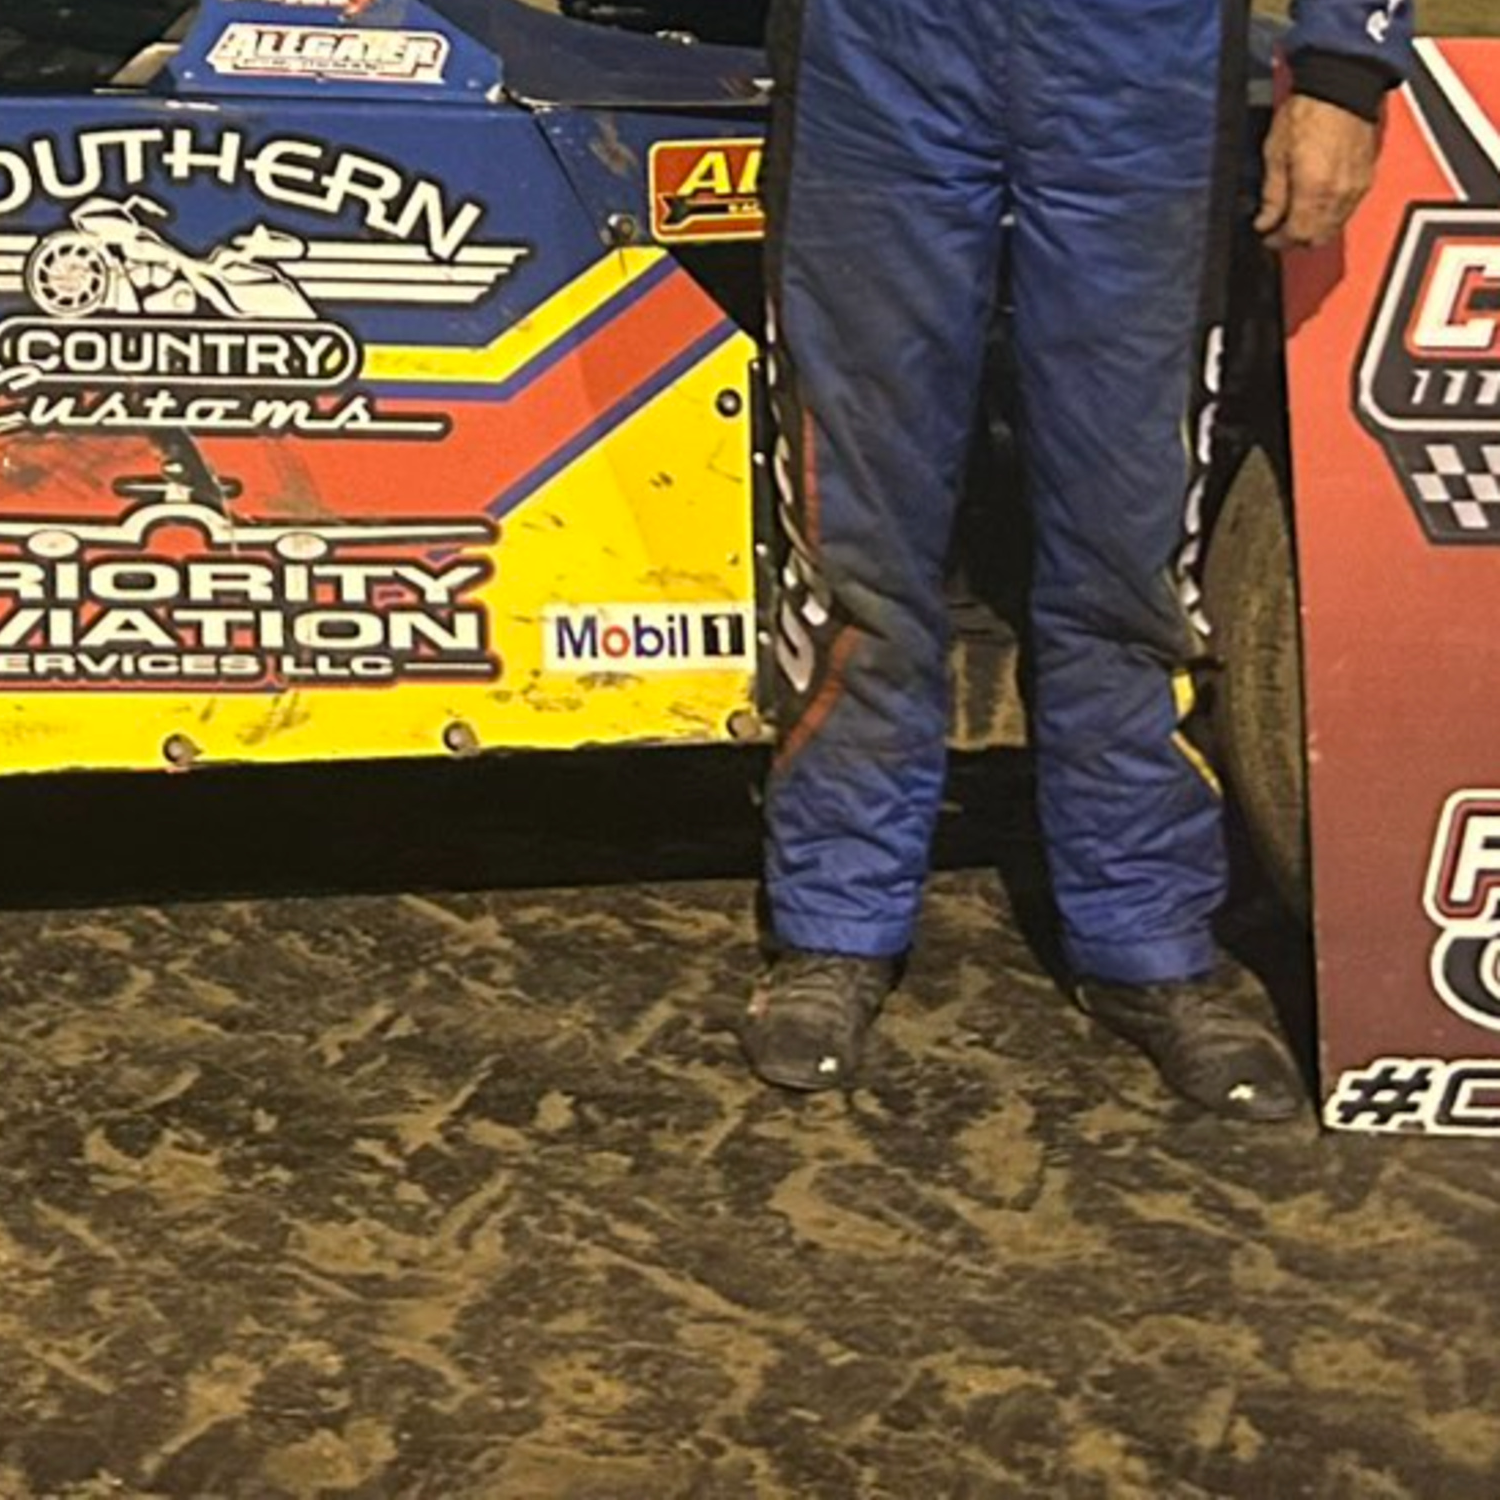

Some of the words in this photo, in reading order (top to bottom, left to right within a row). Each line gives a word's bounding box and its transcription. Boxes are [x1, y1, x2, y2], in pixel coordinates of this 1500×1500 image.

[18, 330, 333, 375] COUNTRY
[556, 614, 690, 658] Mobil
[282, 654, 394, 676] LLC
